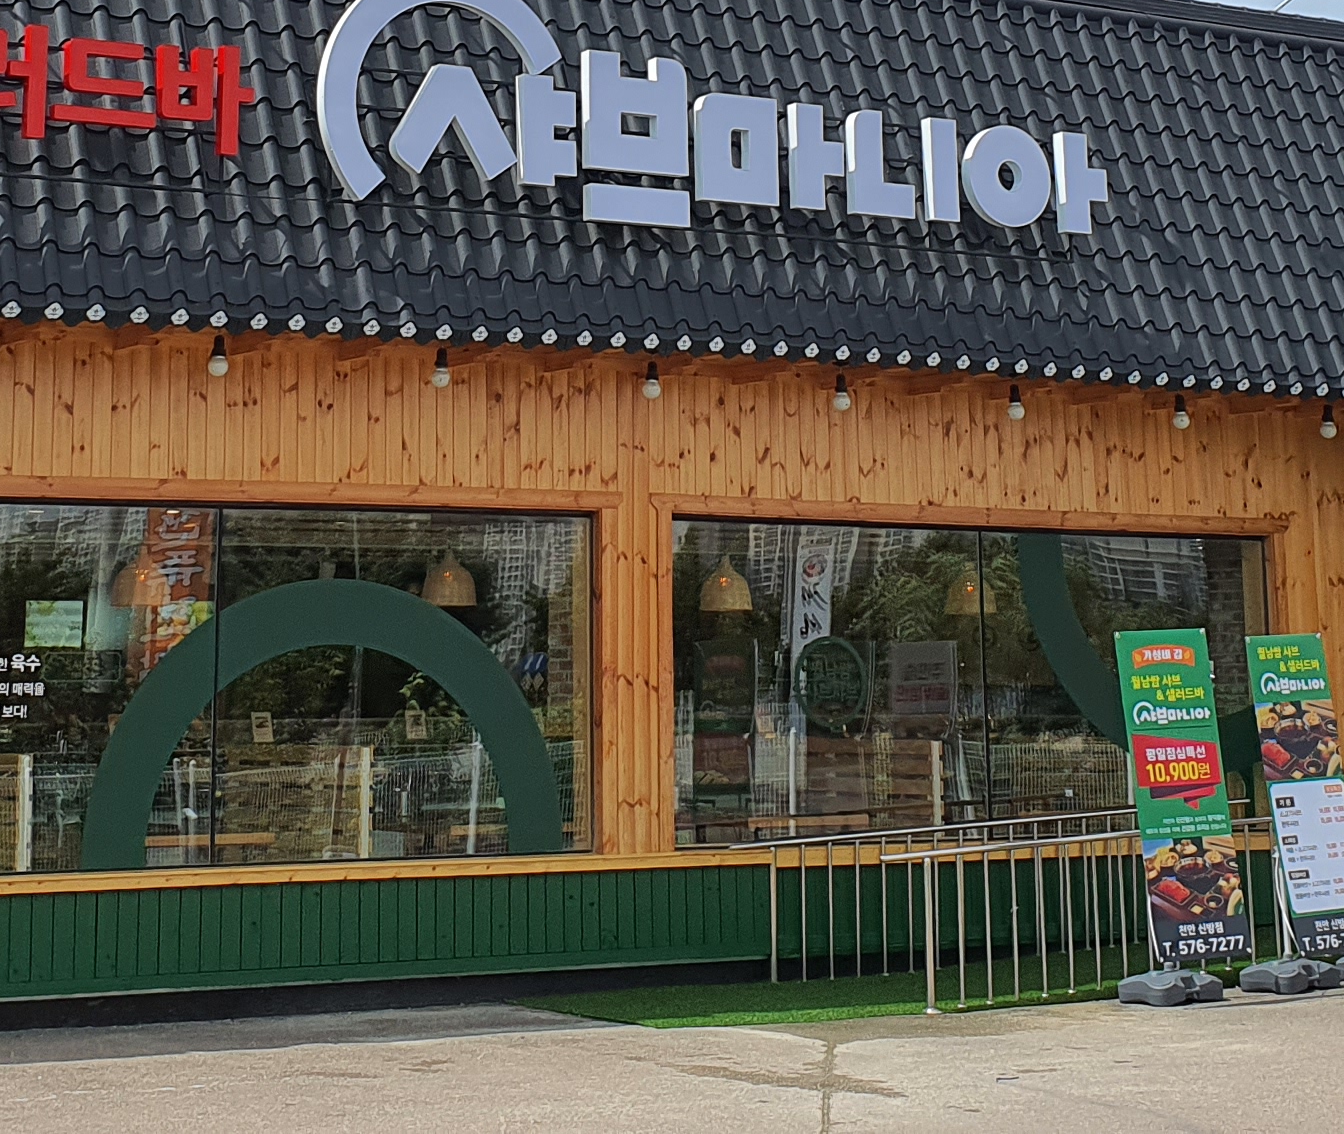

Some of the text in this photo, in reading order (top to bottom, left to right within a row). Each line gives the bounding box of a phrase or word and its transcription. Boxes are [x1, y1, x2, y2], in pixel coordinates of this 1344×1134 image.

[381, 26, 1109, 237] 샤브마니아
[10, 653, 41, 672] 육수
[1287, 659, 1320, 673] 샐러드바
[1162, 674, 1182, 687] 샤브
[1265, 676, 1326, 695] 샤브마니아
[12, 682, 45, 697] 매력을
[1166, 687, 1205, 702] 샐러드바
[1, 704, 28, 719] 보다!
[1138, 704, 1211, 725] 샤브마니아
[1145, 745, 1206, 762] 평일점심특선
[1146, 761, 1211, 783] 10,900원
[1178, 921, 1224, 937] 천안 신방점
[1315, 920, 1330, 932] 천안
[1163, 935, 1245, 957] T. 576-7277
[1302, 937, 1315, 952] T.
